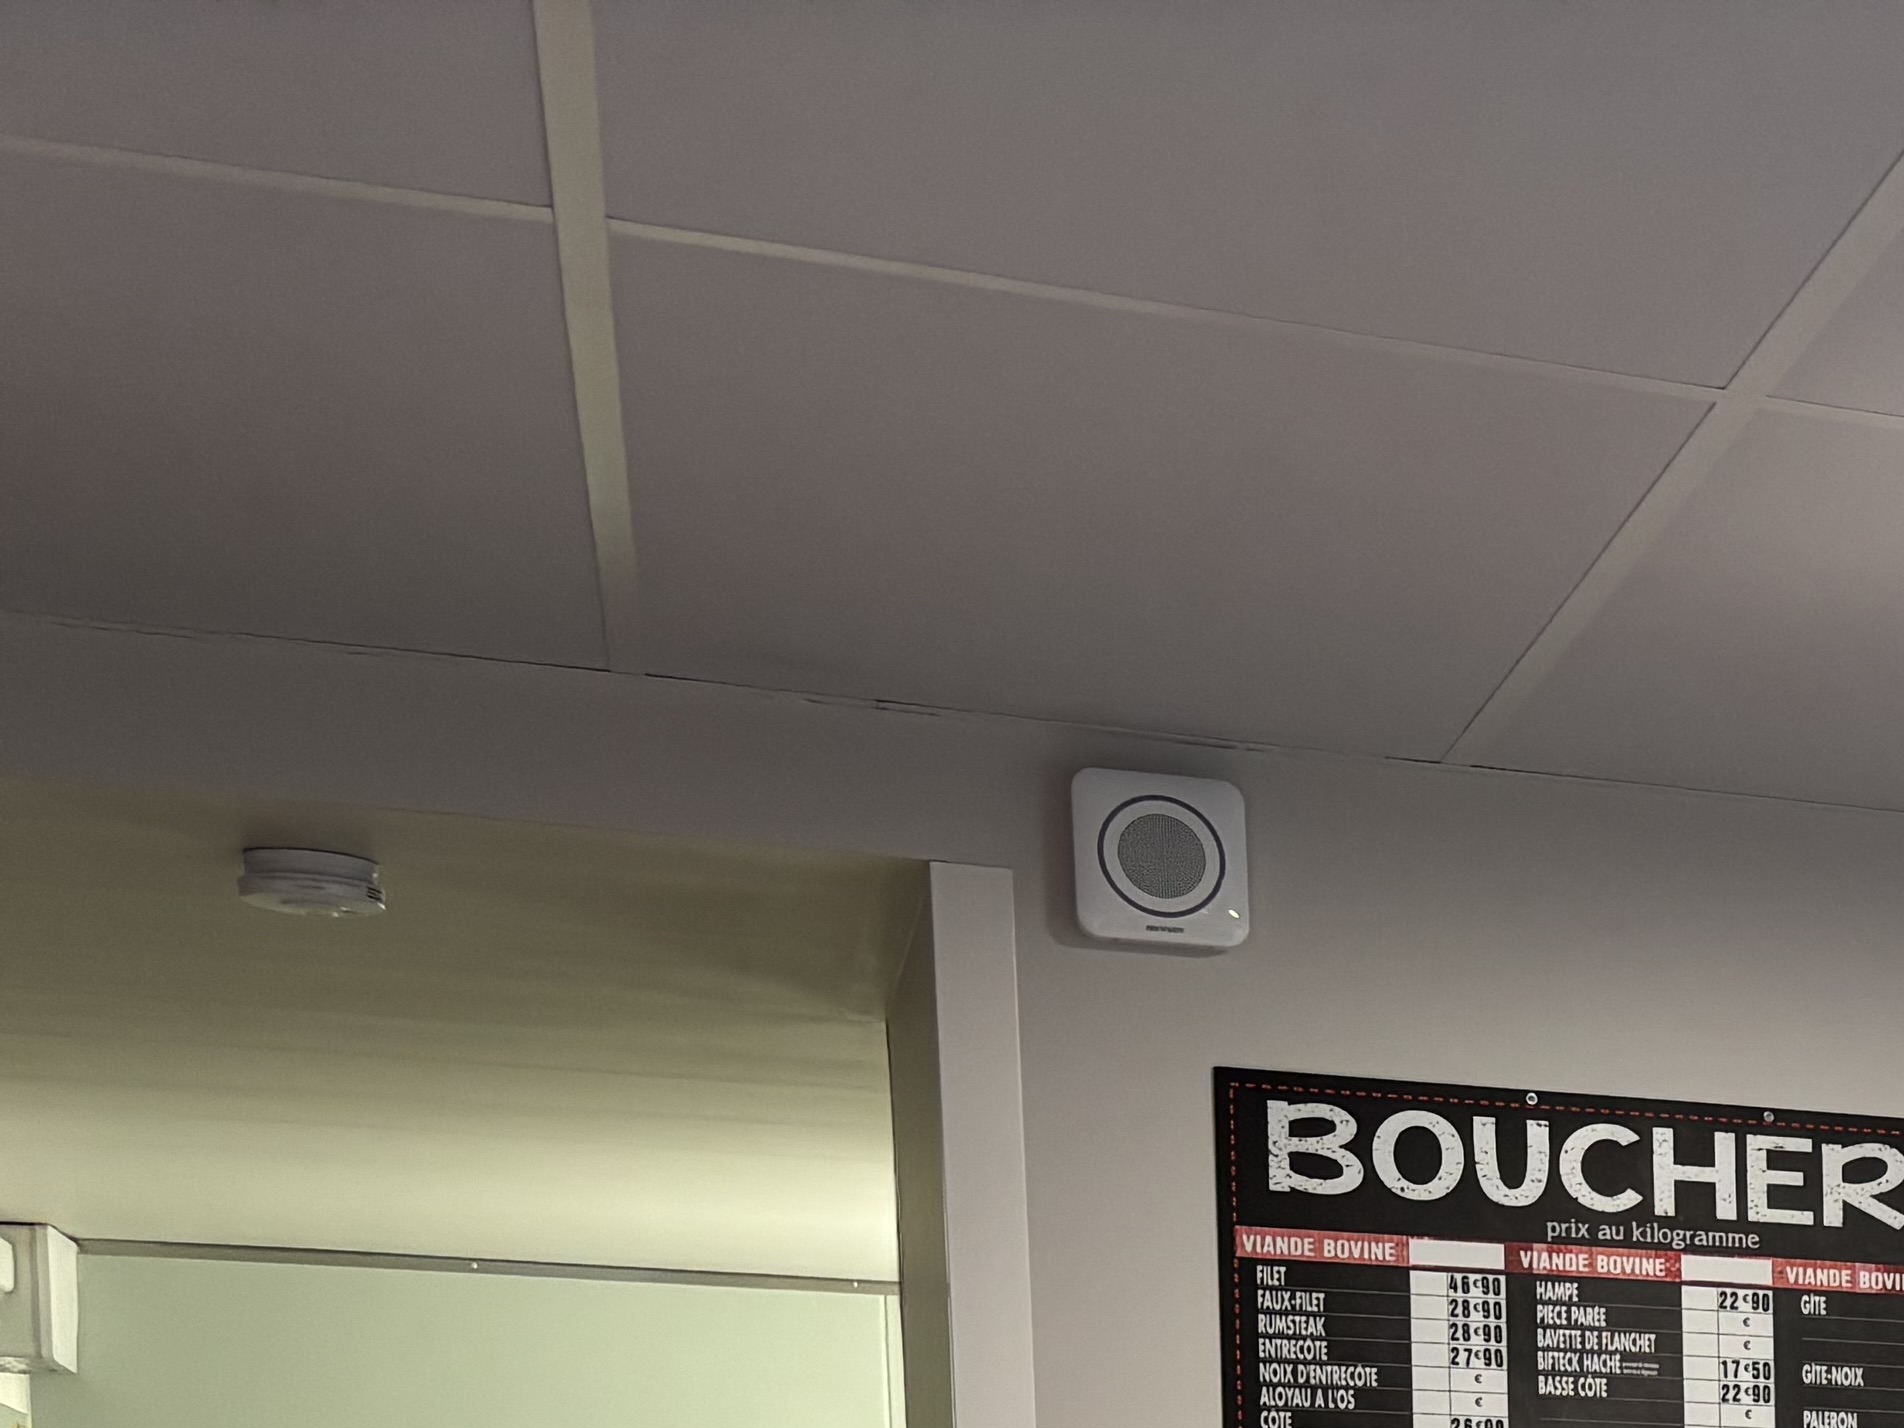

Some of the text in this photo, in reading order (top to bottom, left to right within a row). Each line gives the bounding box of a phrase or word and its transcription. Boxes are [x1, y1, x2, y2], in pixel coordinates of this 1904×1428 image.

[1546, 1219, 1760, 1249] prix au kilogramme
[1242, 1234, 1397, 1262] VIANDE BOVINE
[1520, 1250, 1666, 1278] VIANDE BOVINE
[1257, 1266, 1286, 1286] FILET
[1786, 1266, 1852, 1287] VIANDE
[1258, 1290, 1325, 1312] FAUX-FILET
[1536, 1282, 1579, 1302] HAMPE
[1258, 1315, 1325, 1336] RUMSTEAK
[1259, 1337, 1328, 1361] ENTRECÔTE
[1537, 1351, 1621, 1373] BIFTECK HACHÉ
[1259, 1364, 1378, 1387] NOIX D'ENTRECÔTE
[1260, 1387, 1355, 1409] ALOYAU A L'OS
